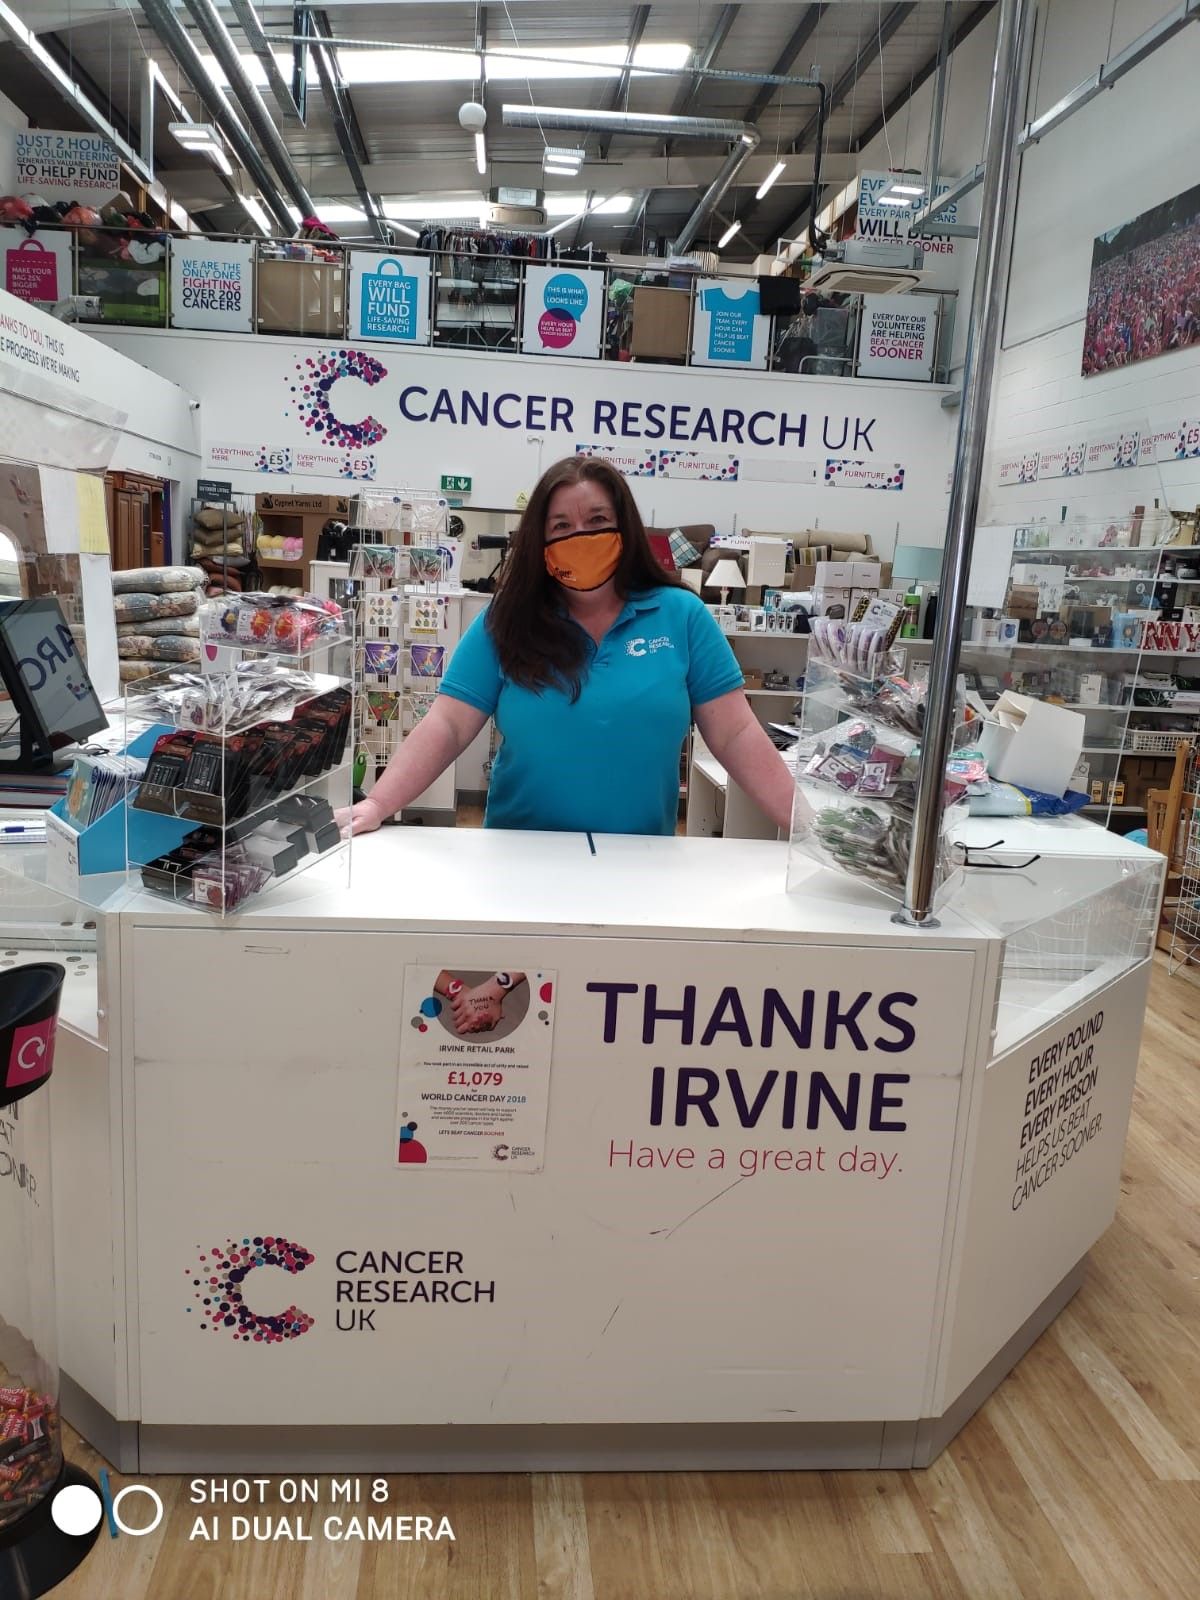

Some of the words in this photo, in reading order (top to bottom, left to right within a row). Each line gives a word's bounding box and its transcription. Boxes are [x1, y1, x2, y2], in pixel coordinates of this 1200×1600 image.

[17, 134, 52, 148] JUST
[56, 138, 64, 148] 2
[69, 138, 116, 152] HOUR
[17, 148, 32, 156] OF
[34, 148, 118, 162] VOLUNTEERING
[17, 157, 56, 166] GENERATES
[17, 164, 37, 176] TO
[42, 165, 75, 178] HELP
[80, 168, 118, 181] FUND
[18, 176, 70, 187] LIFE-SAVING
[74, 180, 118, 190] RESEARCH
[860, 208, 887, 217] EVERY
[890, 210, 910, 219] PAIR
[860, 218, 903, 238] WILL
[182, 260, 198, 268] WE
[201, 261, 219, 270] ARE
[222, 262, 240, 272] THE
[183, 268, 210, 278] ONLY
[213, 270, 240, 280] ONES
[183, 278, 240, 290] FIGHTING
[394, 281, 410, 289] BAG
[183, 288, 215, 299] OVER
[219, 290, 241, 300] 200
[368, 287, 410, 304] WILL
[183, 298, 241, 311] CANCERS
[368, 302, 410, 317] FUND
[368, 316, 410, 325] LIFE-SAVING
[872, 321, 926, 332] VOLUNTEERS
[368, 324, 410, 333] RESEARCH
[871, 329, 886, 338] ARE
[889, 331, 924, 340] HELPING
[19, 322, 28, 338] TO
[45, 334, 58, 353] THIS
[892, 340, 924, 348] CANCER
[870, 346, 922, 360] SOONER
[6, 339, 39, 365] PROGRESS
[59, 362, 79, 383] MAKING
[400, 386, 574, 433] CANCER
[594, 400, 807, 447] RESEARCH
[823, 416, 877, 452] UK
[1187, 429, 1200, 444] £5
[1123, 441, 1133, 455] £5
[212, 448, 254, 457] EVERYTHING
[270, 454, 283, 465] £5
[297, 454, 338, 464] EVERYTHING
[353, 460, 368, 471] £5
[600, 456, 636, 466] URNITURE
[1071, 452, 1079, 464] £5
[678, 462, 720, 470] FURNITURE
[1026, 460, 1034, 472] £5
[844, 470, 886, 480] FURNITURE
[274, 500, 293, 508] Cygnet
[586, 982, 918, 1053] THANKS
[1029, 1037, 1065, 1084] EVERY
[1065, 1011, 1104, 1056] POUND
[448, 1071, 503, 1086] £1,079
[1024, 1069, 1062, 1117] EVERY
[1062, 1044, 1094, 1087] HOUR
[650, 1066, 910, 1132] IRVINE
[1020, 1100, 1057, 1150] EVERY
[1057, 1066, 1099, 1118] PERSON
[1016, 1132, 1051, 1182] HELPS
[1052, 1119, 1068, 1149] US
[1067, 1096, 1092, 1136] BEAT
[609, 1140, 695, 1169] Have
[708, 1148, 726, 1169] a
[739, 1146, 826, 1177] great
[838, 1145, 902, 1180] day.
[1012, 1154, 1057, 1212] CANCER
[1059, 1112, 1103, 1168] SOONER.
[336, 1250, 464, 1274] CANCER
[336, 1280, 495, 1303] RESEARCH
[336, 1309, 376, 1331] UK
